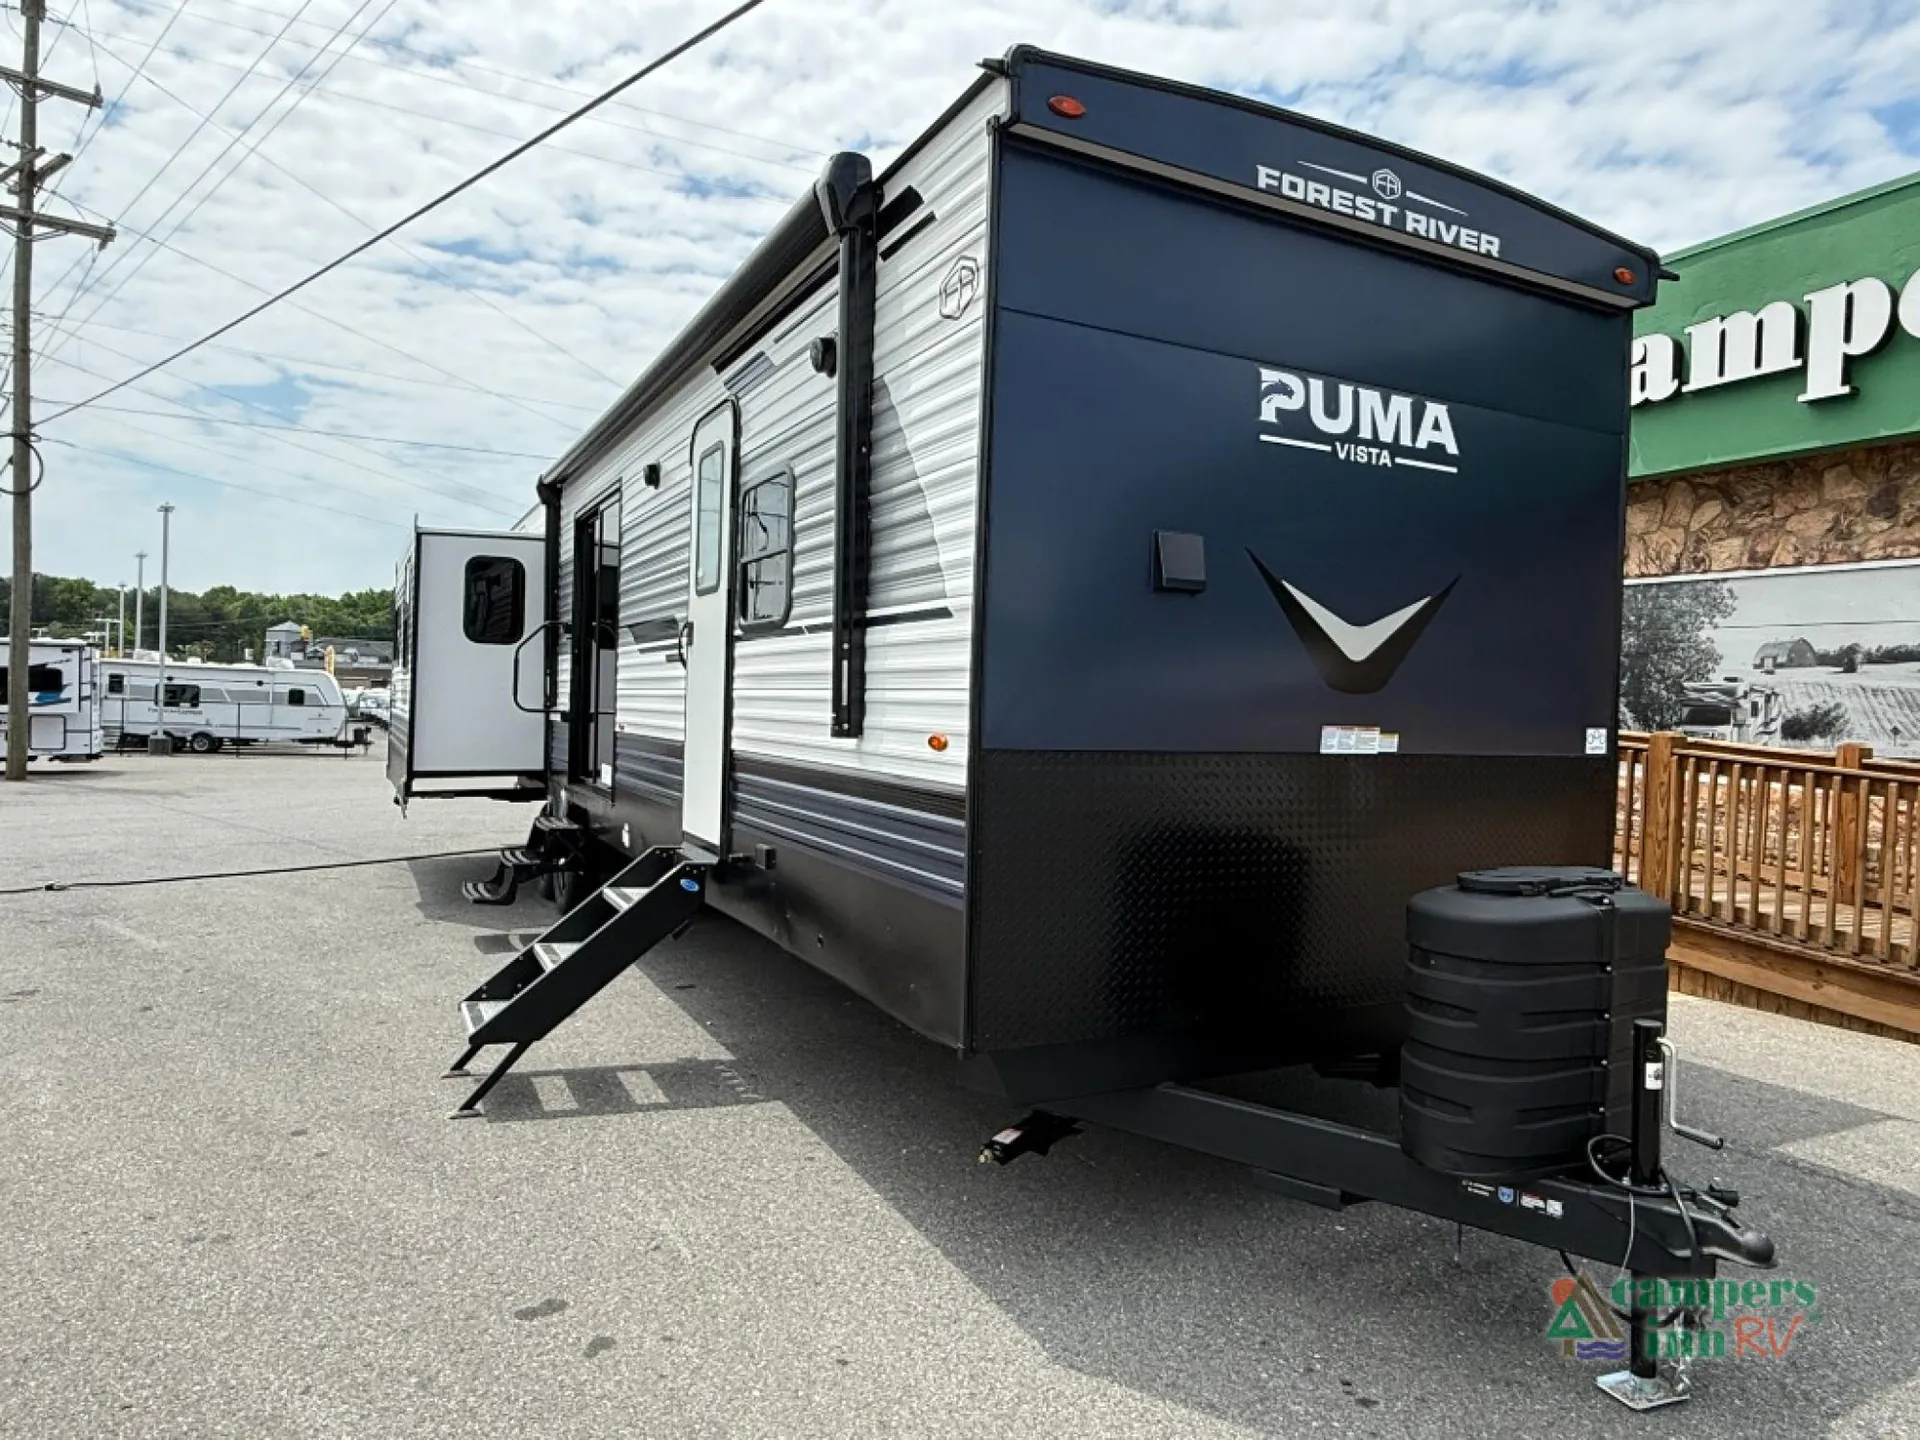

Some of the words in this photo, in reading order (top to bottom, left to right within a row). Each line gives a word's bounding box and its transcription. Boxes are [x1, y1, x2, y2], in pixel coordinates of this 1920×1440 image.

[1256, 165, 1399, 226] FOREST
[1405, 209, 1501, 257] RIVER
[1259, 367, 1459, 455] PUMA
[1335, 442, 1392, 468] VISTA
